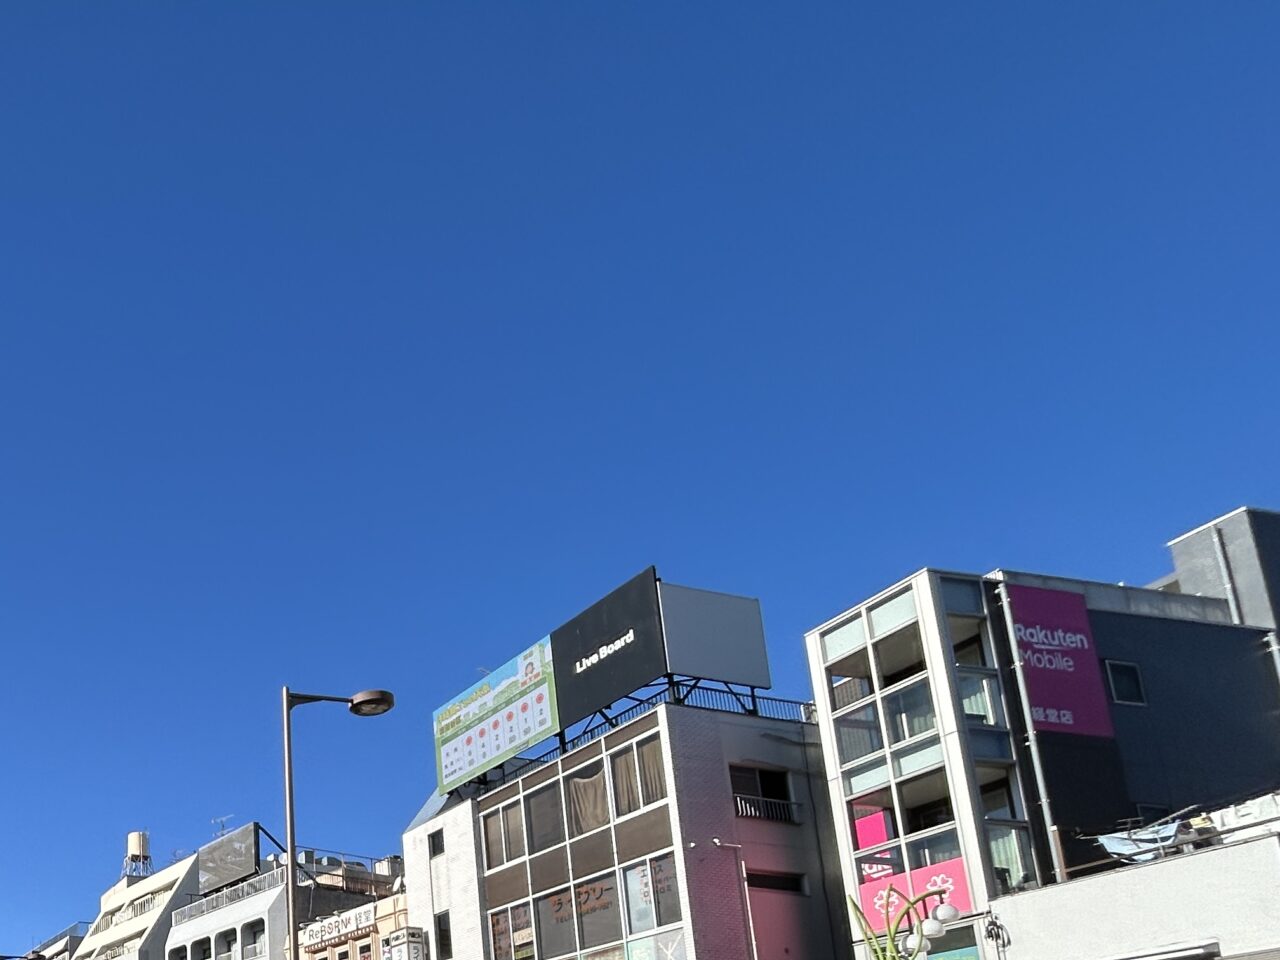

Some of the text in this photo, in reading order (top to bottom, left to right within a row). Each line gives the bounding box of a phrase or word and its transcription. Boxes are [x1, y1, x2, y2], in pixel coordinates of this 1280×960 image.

[1015, 624, 1088, 649] Rakuten
[575, 650, 600, 675] Live
[599, 628, 635, 660] Board
[1021, 650, 1075, 672] Mobile
[357, 909, 372, 925] 経堂
